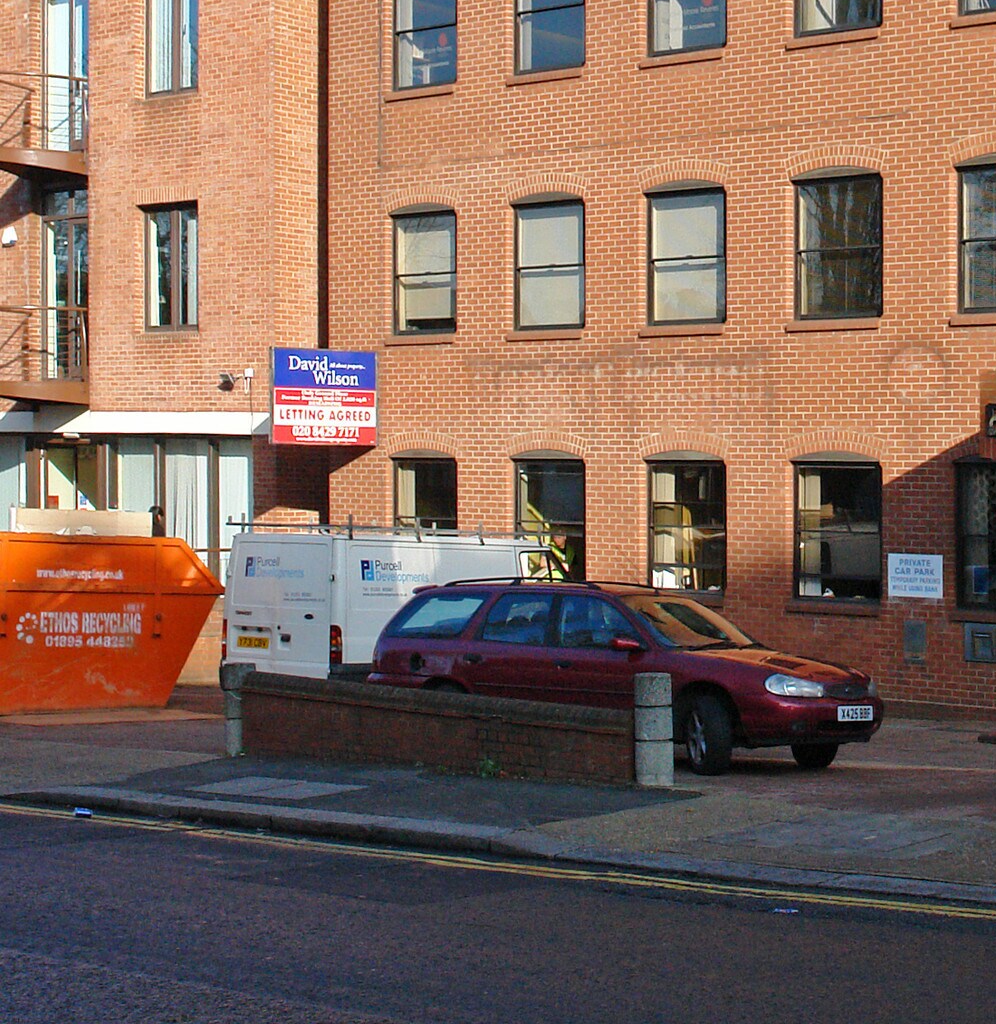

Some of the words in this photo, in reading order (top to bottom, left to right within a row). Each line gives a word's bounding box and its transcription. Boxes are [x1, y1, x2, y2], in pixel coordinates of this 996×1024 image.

[288, 355, 328, 371] David
[312, 370, 360, 386] Wilson
[280, 409, 325, 420] LETTING
[329, 410, 371, 421] AGREED
[292, 425, 311, 436] 020
[338, 426, 359, 438] 7171
[375, 560, 402, 571] Purcell
[899, 558, 931, 567] PRIVATE
[375, 571, 430, 584] Developments
[894, 567, 911, 575] CAR
[914, 568, 935, 576] PARK
[40, 611, 79, 634] ETHOS
[81, 612, 142, 634] RECYCLING
[45, 635, 83, 647] 01895
[841, 707, 859, 719] X425
